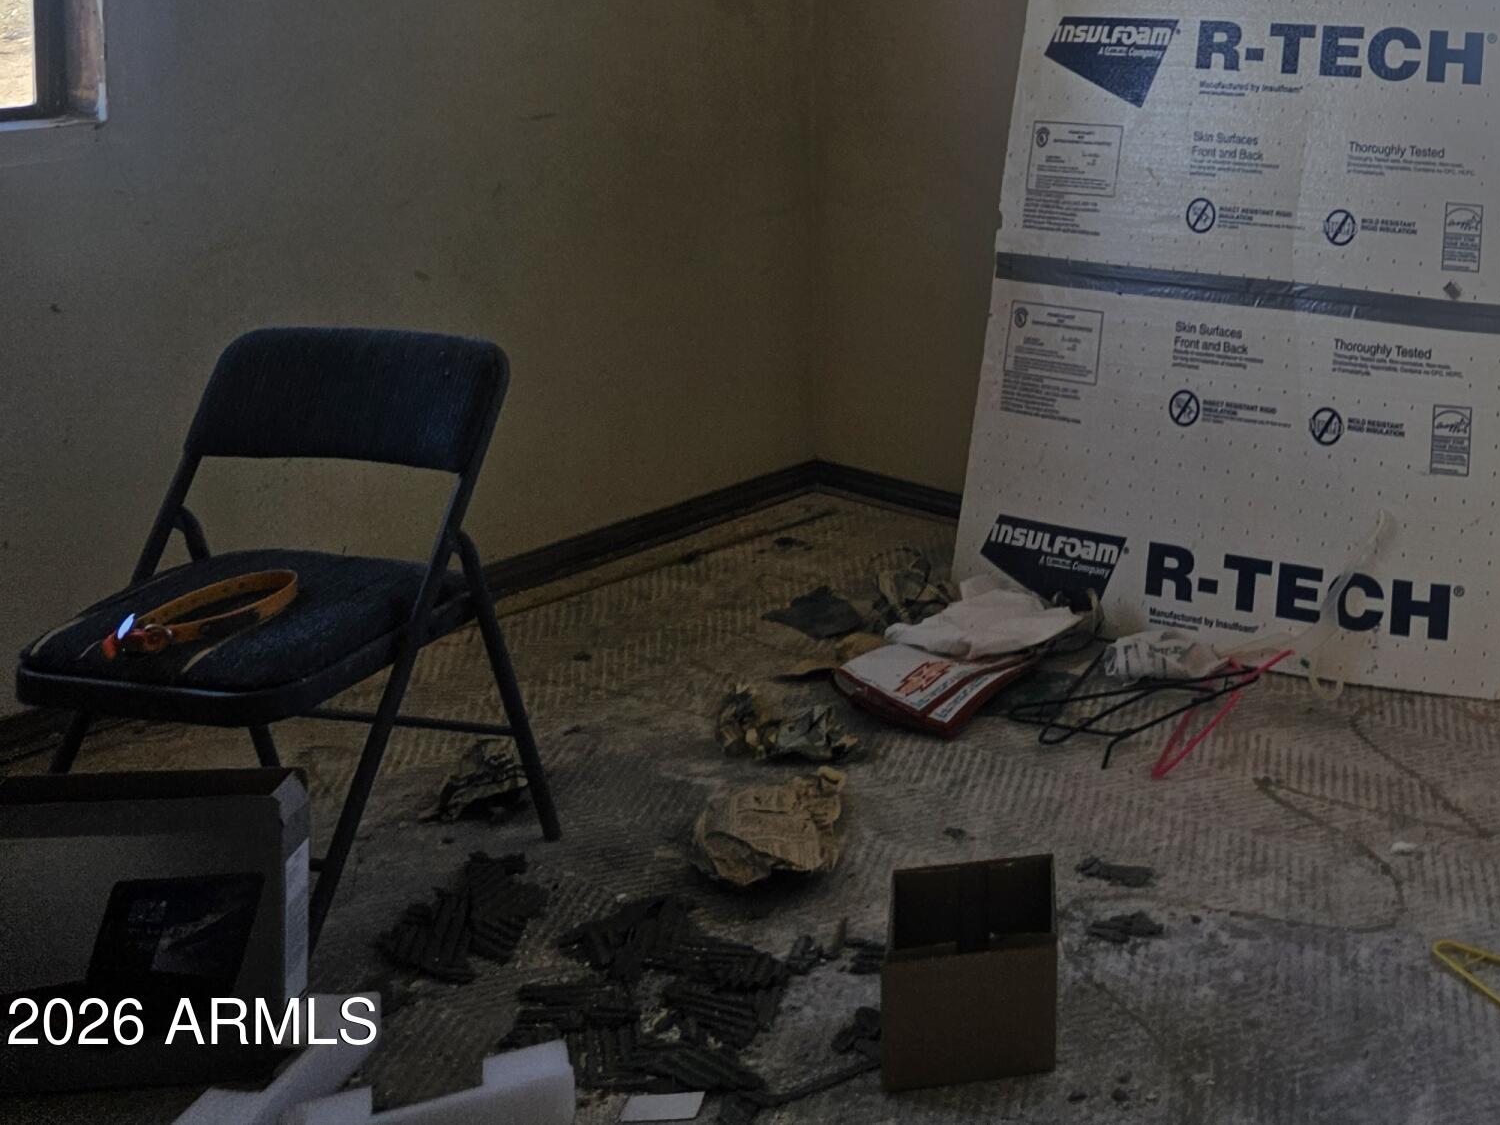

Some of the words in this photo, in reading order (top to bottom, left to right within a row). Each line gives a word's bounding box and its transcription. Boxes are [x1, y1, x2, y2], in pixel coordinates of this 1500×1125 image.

[1193, 130, 1214, 142] Skin
[1216, 132, 1258, 146] Surfaces
[1192, 145, 1216, 159] Front
[1218, 148, 1238, 159] and
[1239, 149, 1264, 161] Back
[1349, 140, 1407, 158] Thoroughly
[1409, 144, 1445, 159] Tested
[1175, 321, 1197, 334] Skin
[1199, 323, 1243, 339] Surfaces
[1174, 335, 1200, 350] Front
[1201, 341, 1221, 352] and
[1223, 341, 1248, 355] Back
[1334, 337, 1393, 357] Thoroughly
[1395, 344, 1432, 360] Tested
[1072, 561, 1112, 580] Company
[1149, 606, 1203, 625] Manufactured
[1204, 616, 1215, 628] by
